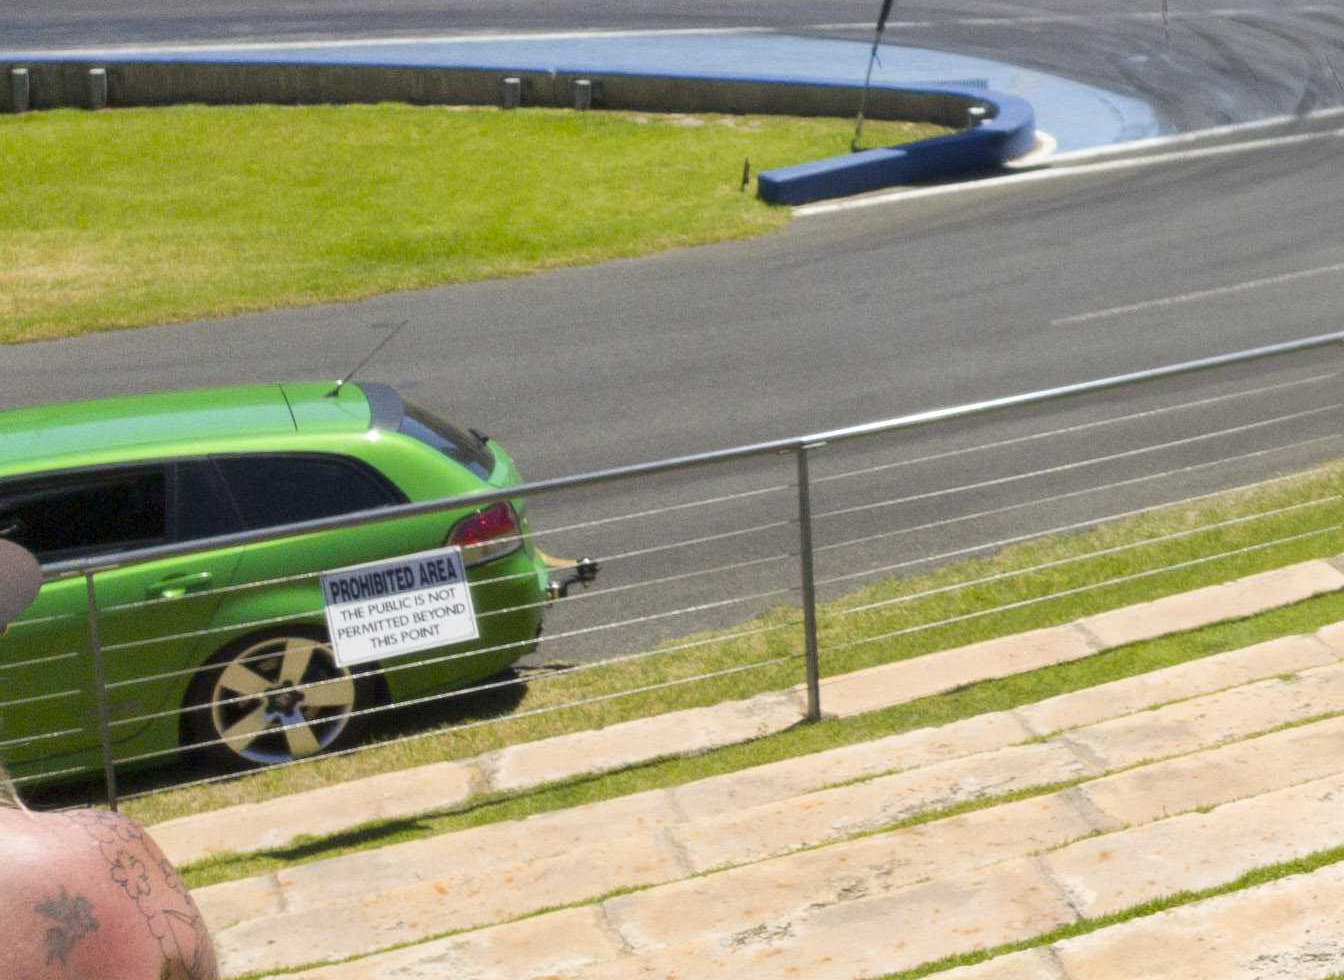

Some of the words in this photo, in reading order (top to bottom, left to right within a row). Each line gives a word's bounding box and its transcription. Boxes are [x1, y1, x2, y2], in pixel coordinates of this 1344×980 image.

[329, 566, 415, 604] PROHIBITED
[420, 557, 458, 586] AREA
[337, 614, 410, 640] PERMITTED
[412, 602, 467, 624] BEYOND
[340, 606, 366, 622] THE
[368, 596, 411, 616] PUBLIC
[415, 594, 425, 606] IS
[428, 587, 456, 604] NOT
[369, 634, 398, 650] THIS
[401, 623, 440, 642] POINT
